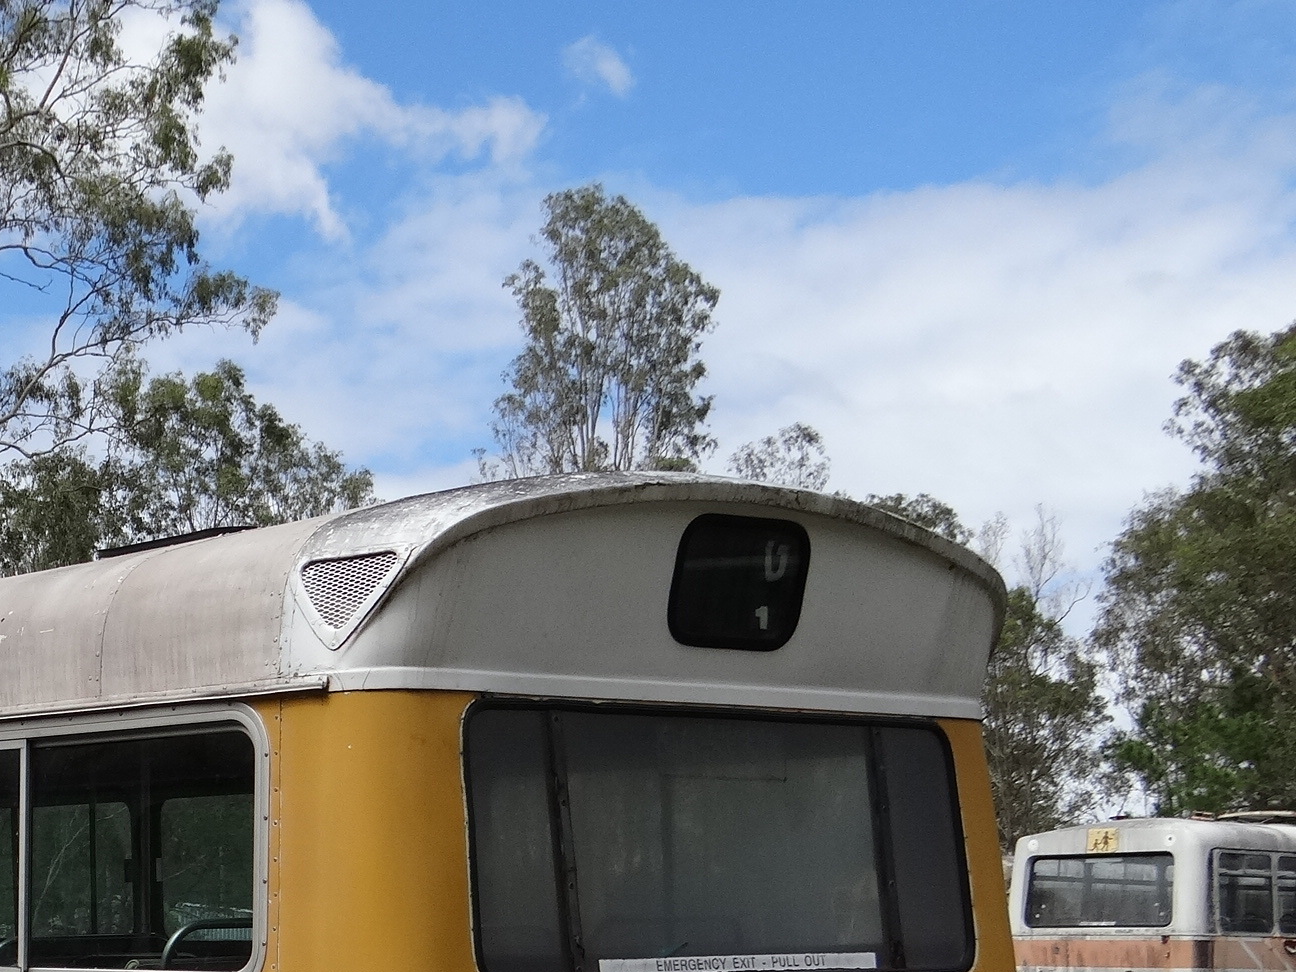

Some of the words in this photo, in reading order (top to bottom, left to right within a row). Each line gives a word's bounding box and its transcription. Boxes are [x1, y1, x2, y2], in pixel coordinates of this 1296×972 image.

[656, 958, 727, 972] EMERGENCY
[732, 957, 756, 969] EXIT
[771, 955, 800, 968] PULL
[804, 955, 826, 967] OUT
